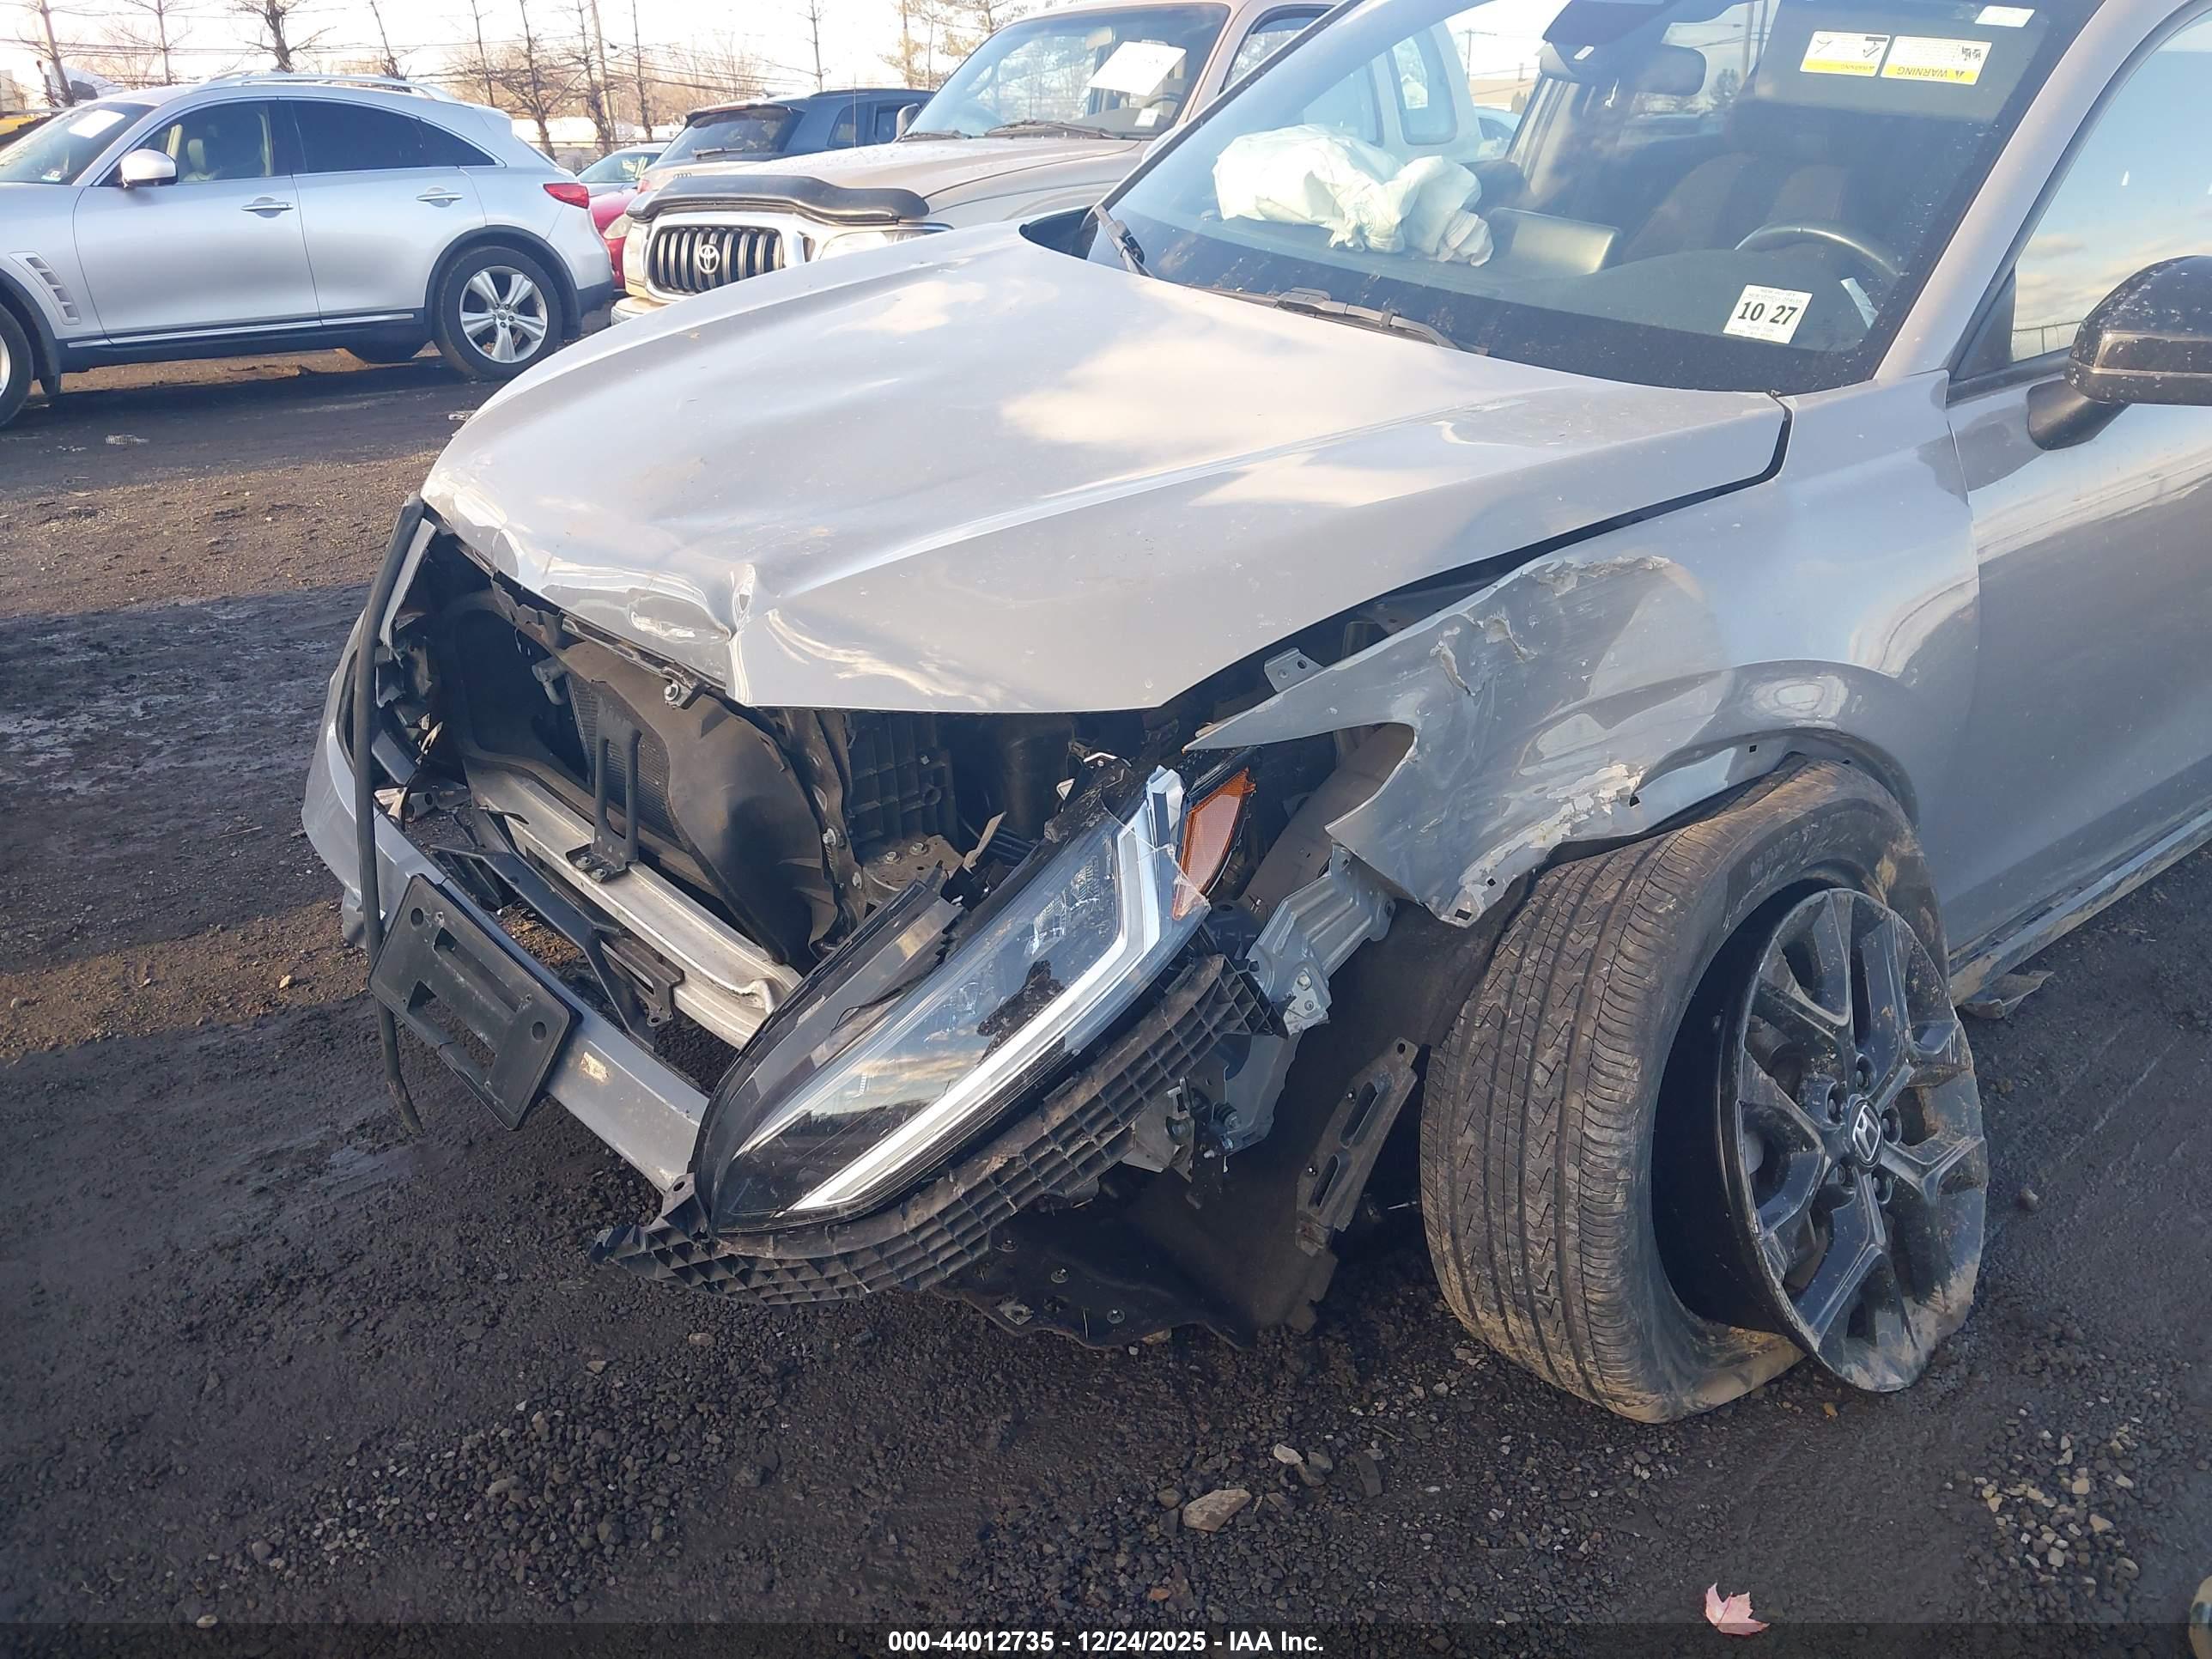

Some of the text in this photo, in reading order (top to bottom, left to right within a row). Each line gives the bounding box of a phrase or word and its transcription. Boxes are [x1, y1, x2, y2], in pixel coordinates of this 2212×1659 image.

[1896, 66, 1948, 77] WARNING
[1738, 301, 1799, 325] 10 27
